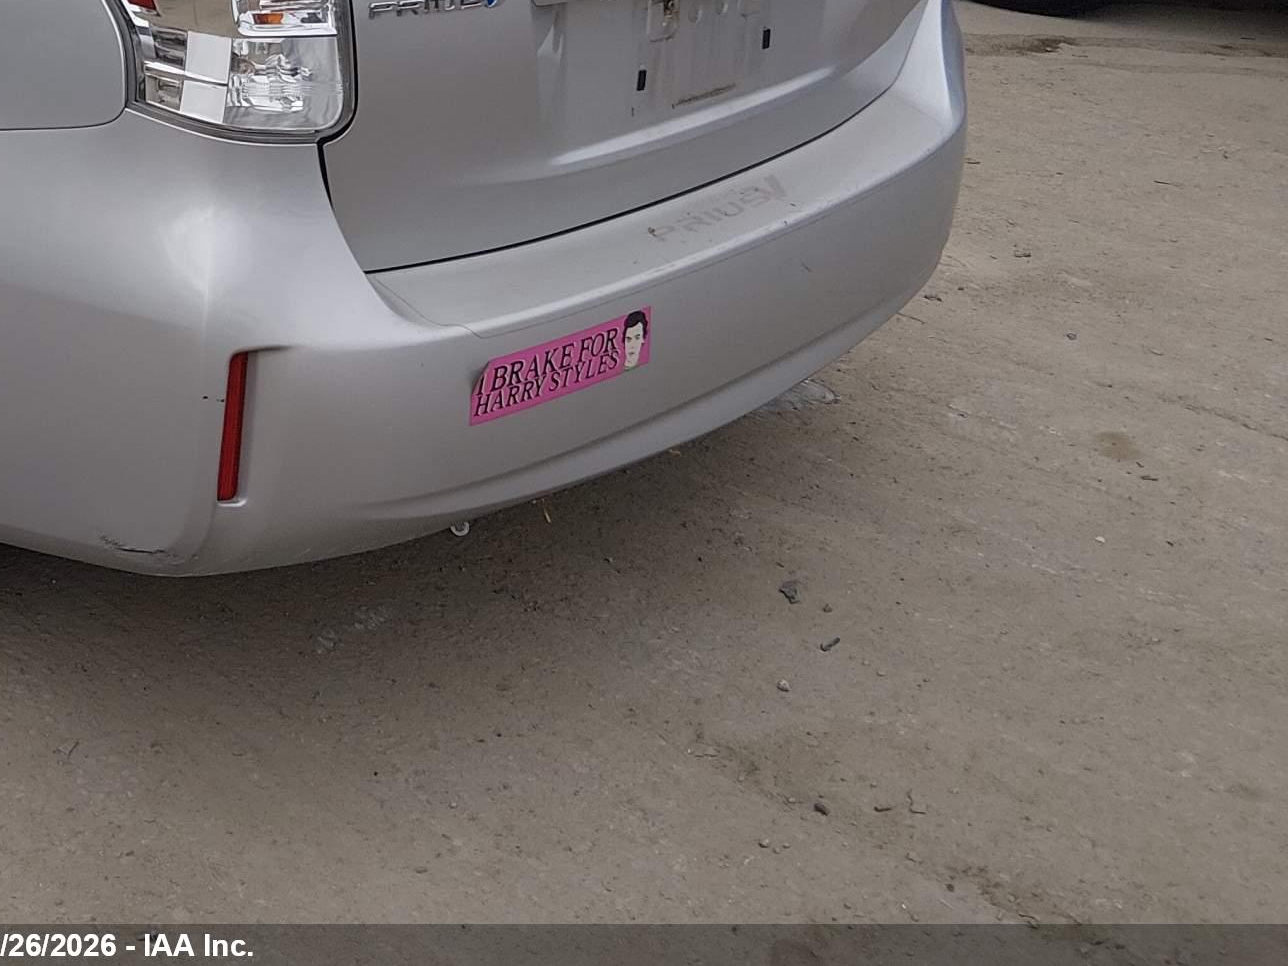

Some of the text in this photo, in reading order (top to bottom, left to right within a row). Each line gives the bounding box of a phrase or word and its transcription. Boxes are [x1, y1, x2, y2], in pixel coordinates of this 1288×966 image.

[473, 350, 620, 418] HARRY STYLES
[490, 342, 575, 391] BRAKE
[578, 327, 619, 363] FOR
